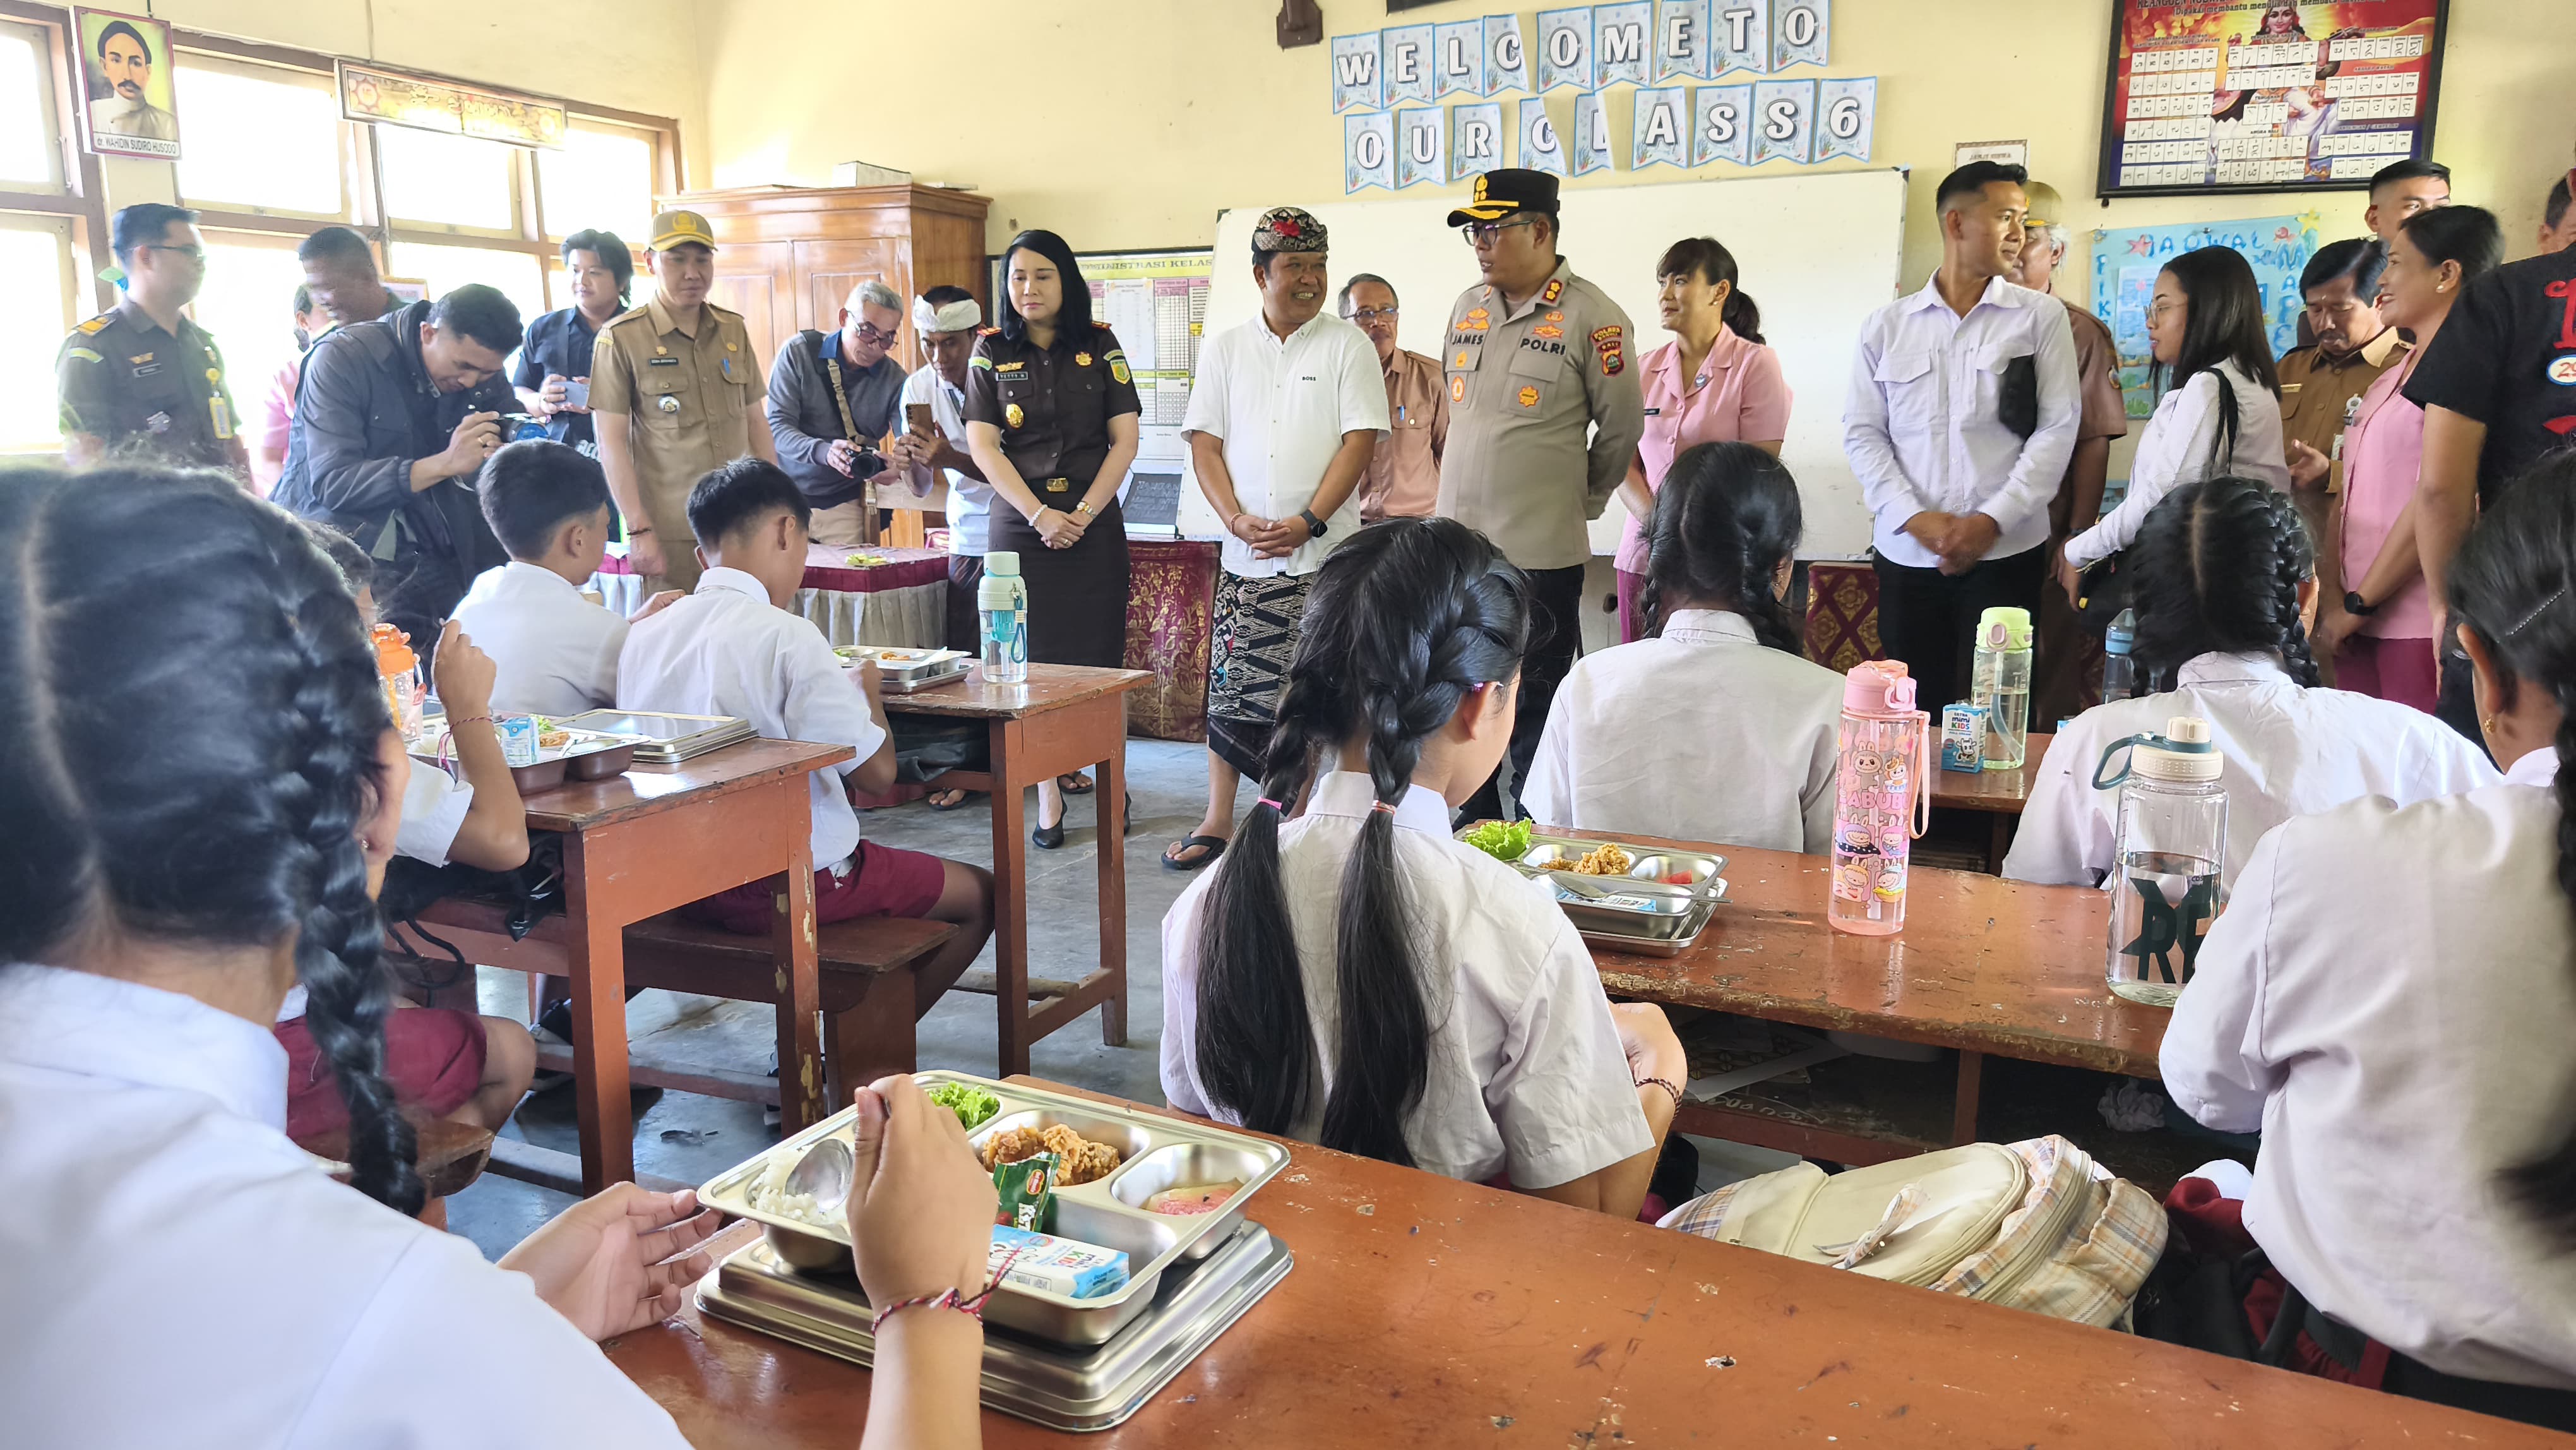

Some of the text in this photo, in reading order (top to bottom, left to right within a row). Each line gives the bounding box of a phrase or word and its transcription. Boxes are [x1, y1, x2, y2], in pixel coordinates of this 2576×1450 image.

[1336, 5, 1819, 88] WELCOME TO
[1356, 119, 1493, 171] OUR
[1828, 96, 1864, 140] 6
[1452, 334, 1484, 345] JAMES
[1520, 338, 1566, 356] POLRI
